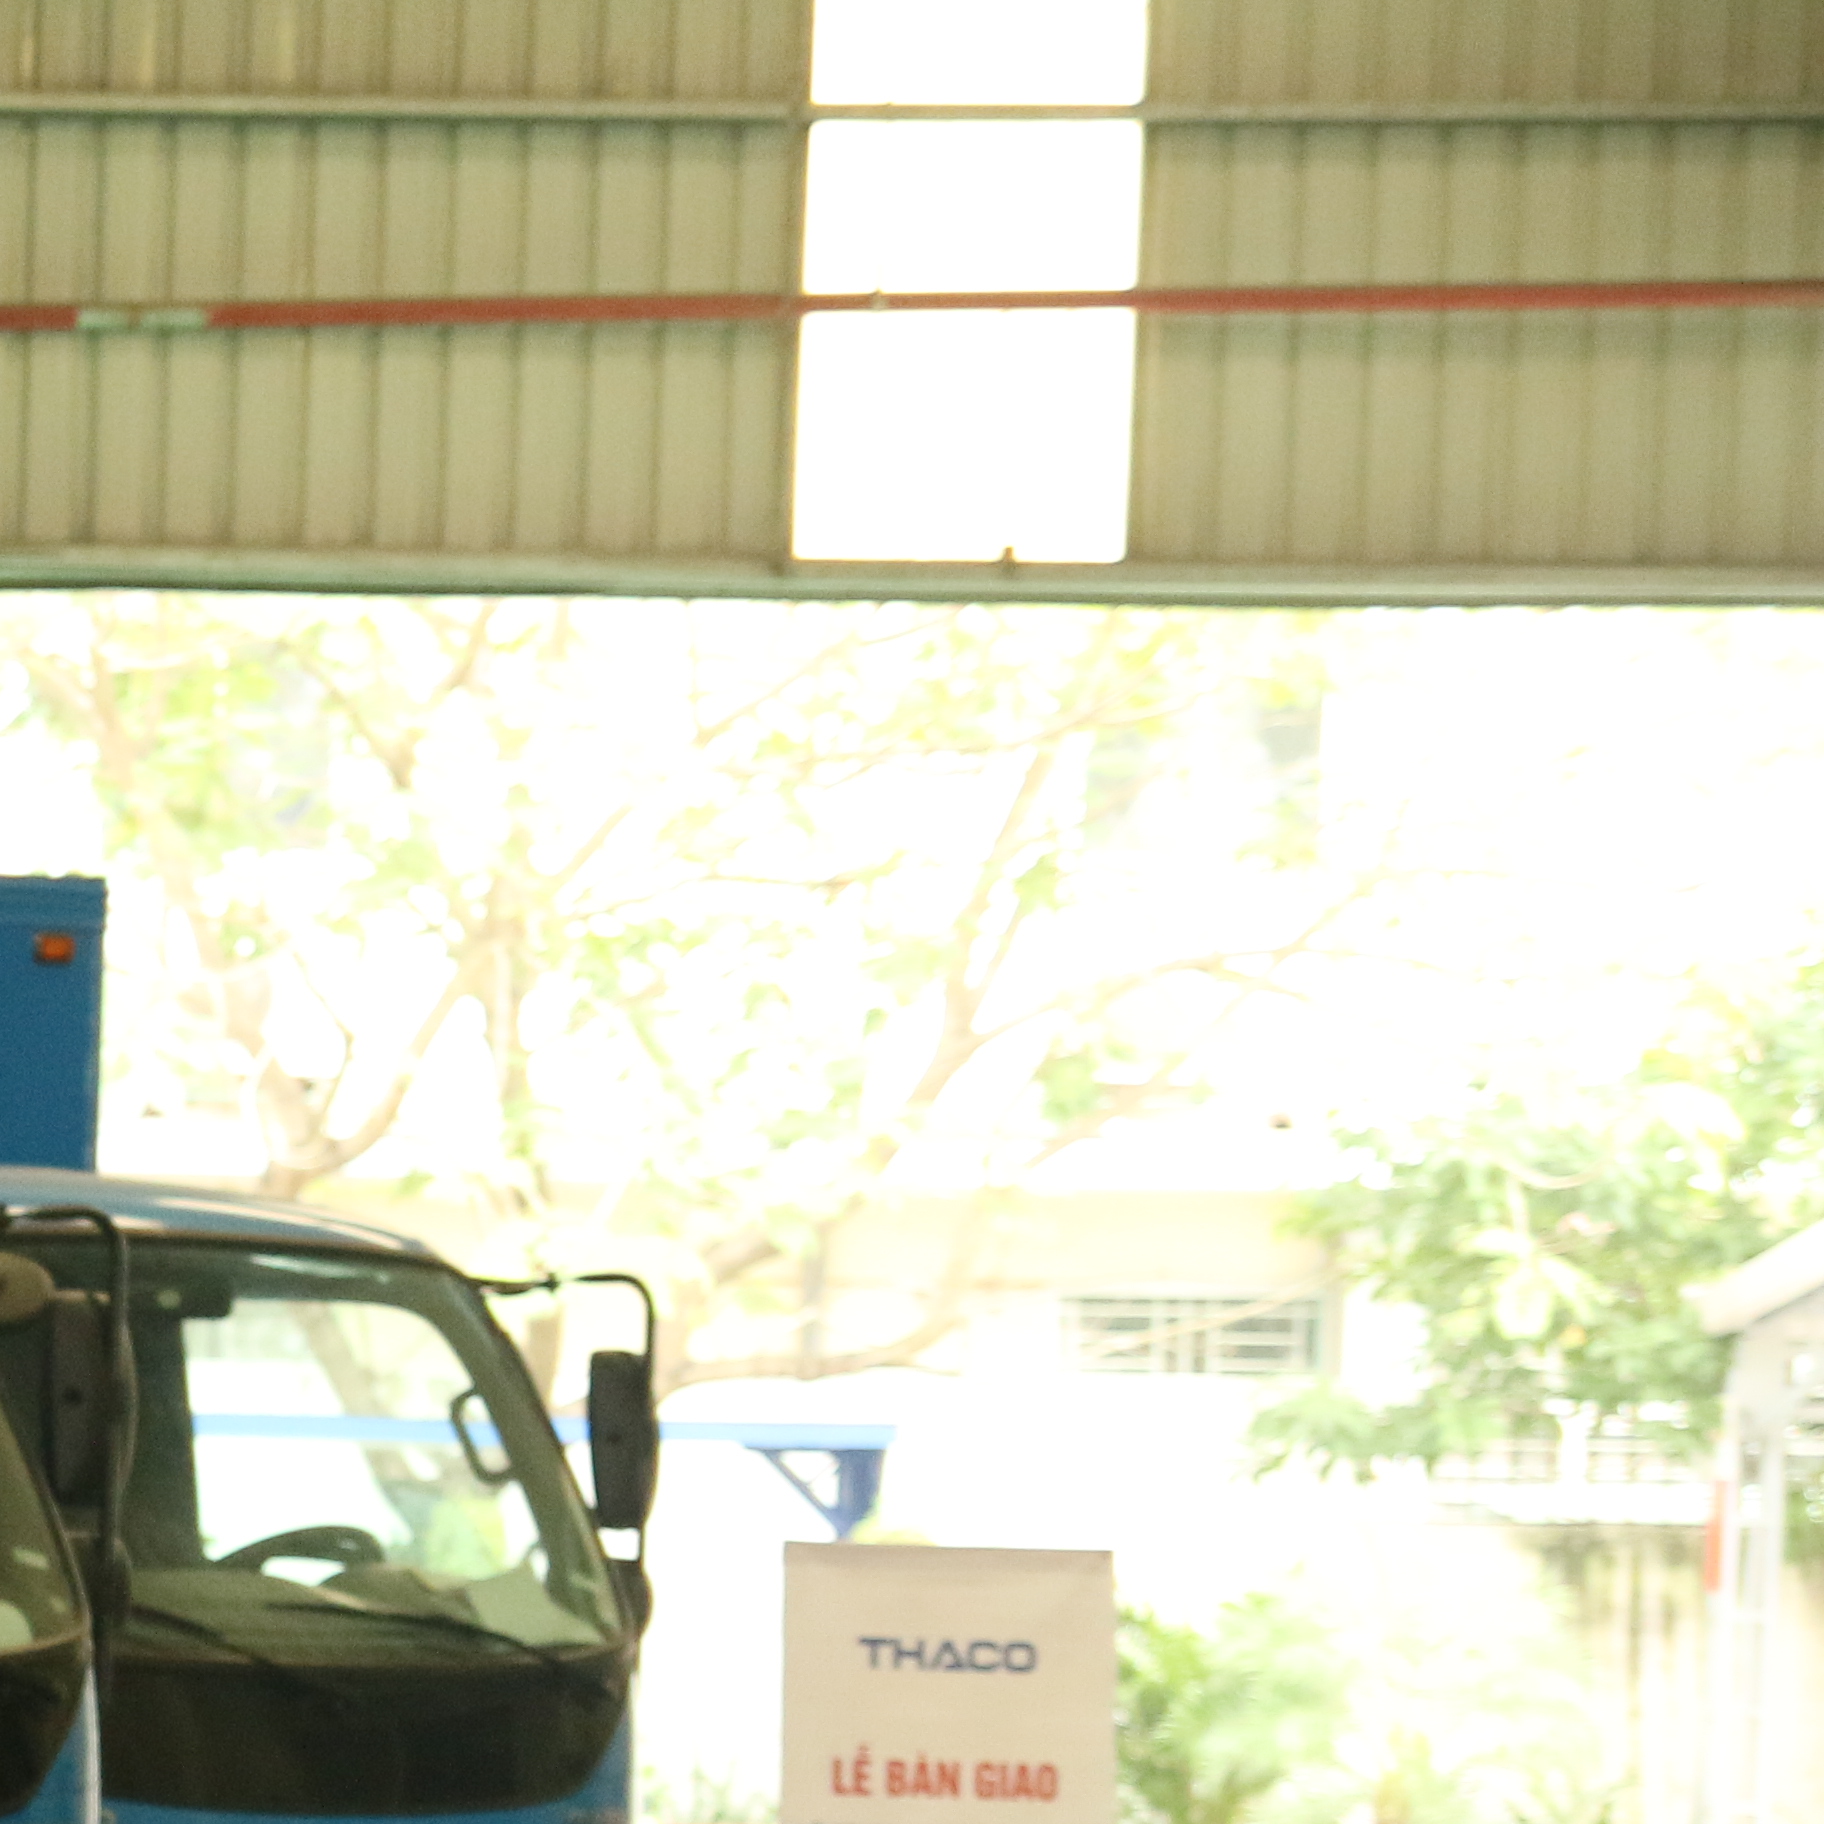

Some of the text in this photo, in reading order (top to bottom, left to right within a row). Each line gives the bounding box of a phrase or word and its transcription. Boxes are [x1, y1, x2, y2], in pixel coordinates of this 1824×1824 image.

[859, 1637, 1037, 1673] THACO
[885, 1751, 960, 1799] BÀN
[975, 1759, 1059, 1802] GIAO
